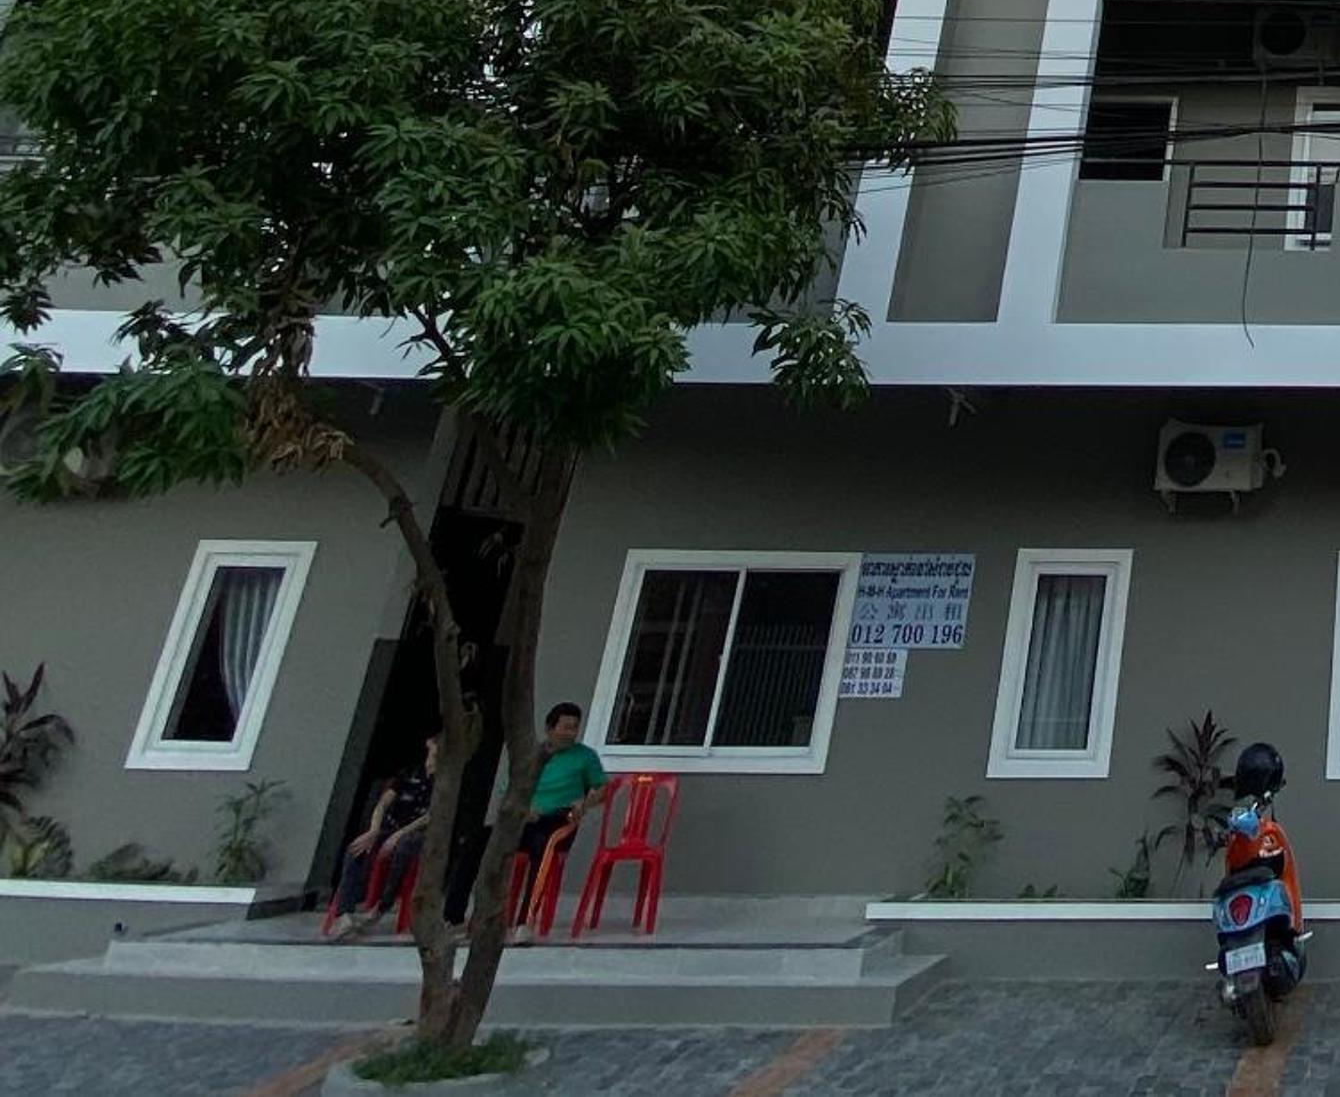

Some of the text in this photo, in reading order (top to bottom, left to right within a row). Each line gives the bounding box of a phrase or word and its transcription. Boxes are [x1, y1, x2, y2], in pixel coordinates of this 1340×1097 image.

[851, 623, 963, 644] 012 700 196
